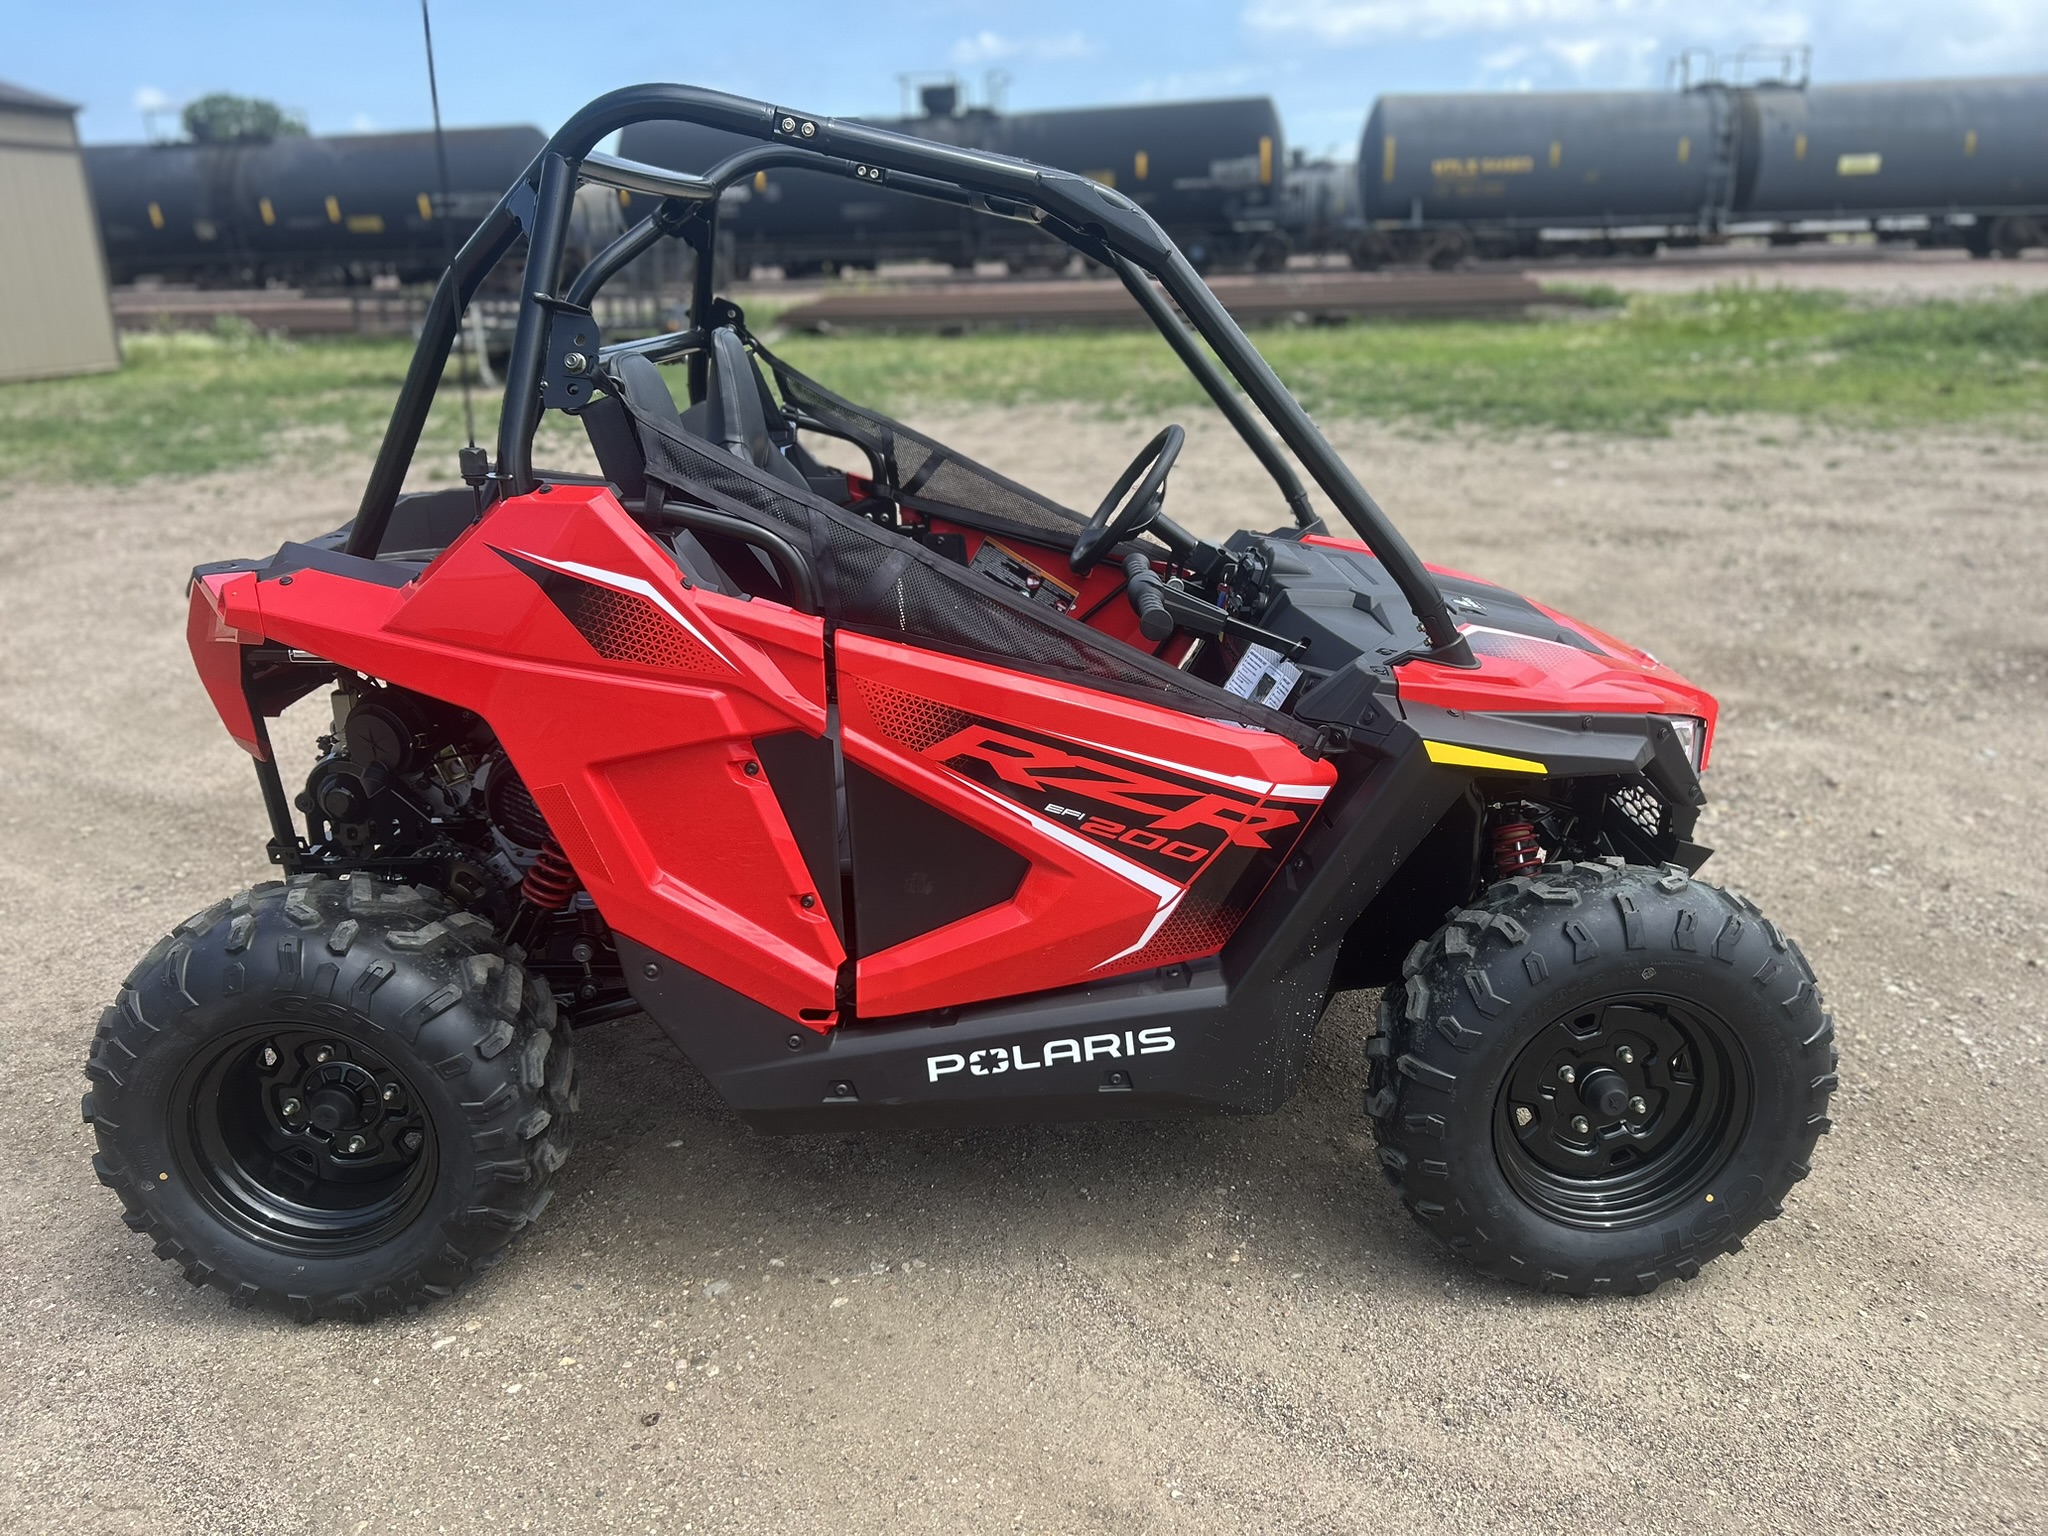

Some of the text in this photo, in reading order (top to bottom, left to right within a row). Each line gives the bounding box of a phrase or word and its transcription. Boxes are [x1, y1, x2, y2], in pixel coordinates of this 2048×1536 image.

[922, 725, 1300, 849] RZR
[1044, 803, 1209, 863] EFI 200
[268, 994, 387, 1036] CST
[927, 1026, 1176, 1082] POLARIS
[1653, 1173, 1764, 1267] CST
